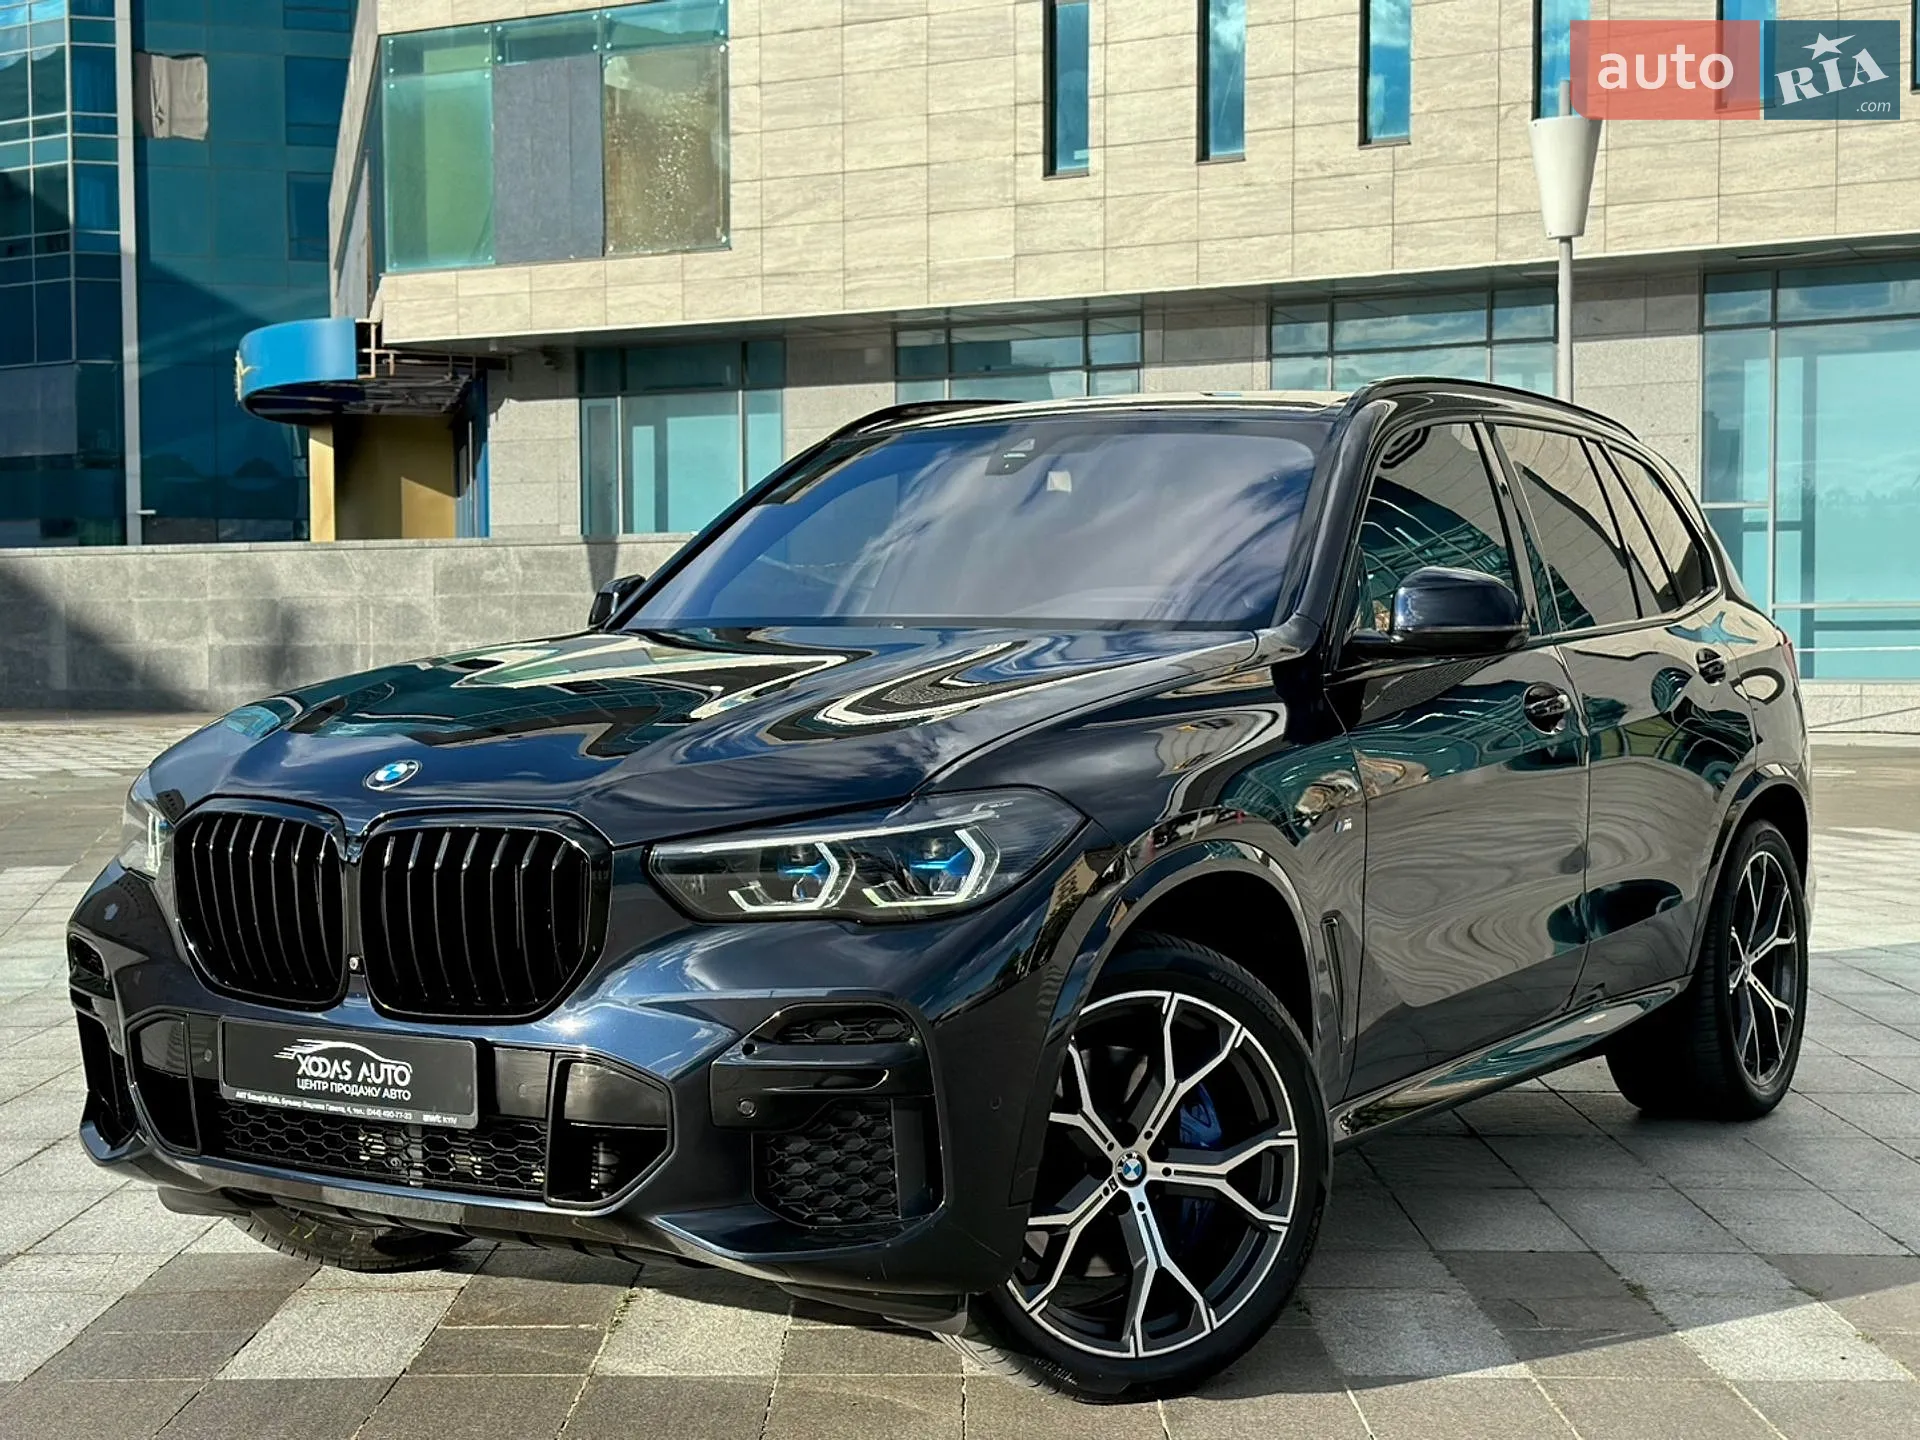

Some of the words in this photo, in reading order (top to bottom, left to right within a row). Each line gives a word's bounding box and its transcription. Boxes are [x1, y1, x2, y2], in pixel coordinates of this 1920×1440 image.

[357, 1062, 412, 1087] AUTO
[297, 1077, 329, 1092] ЦЕНТР
[330, 1081, 381, 1098] ПРОДАЖУ
[381, 1087, 412, 1102] АВТО
